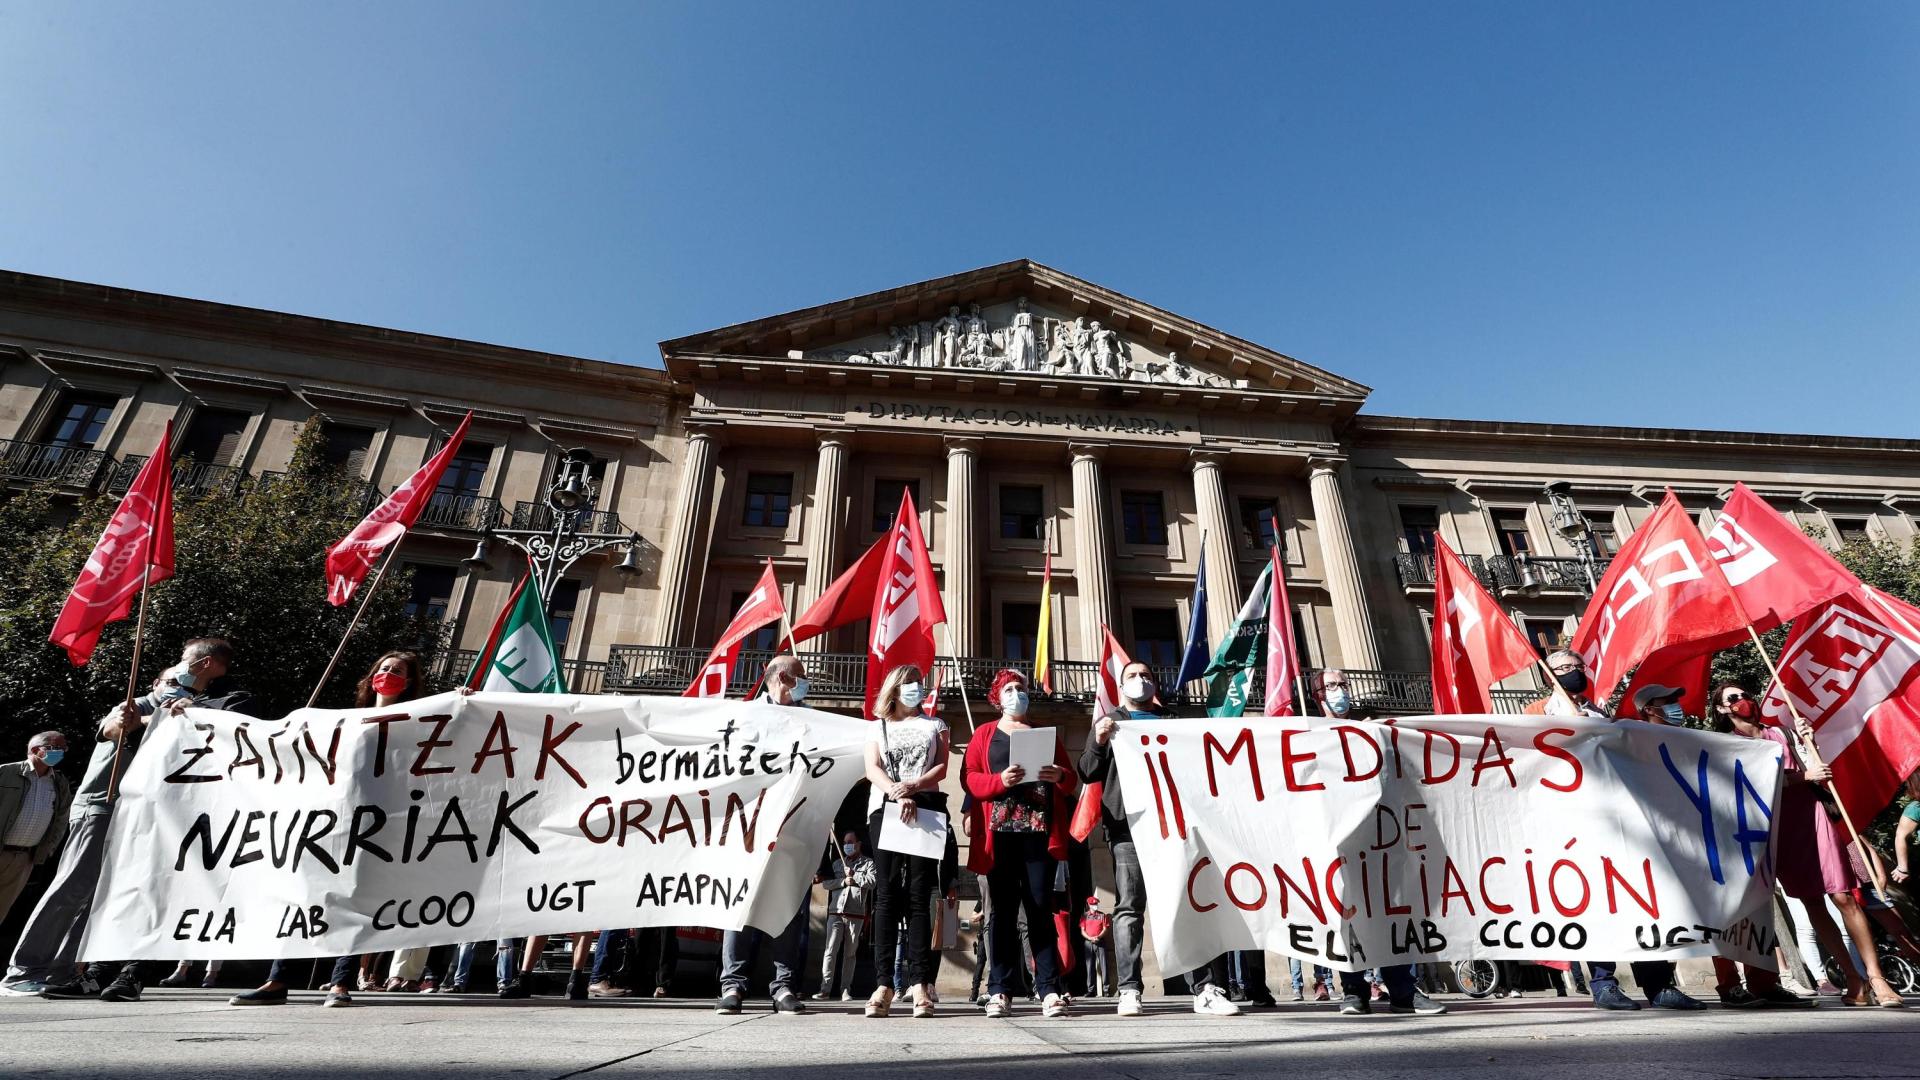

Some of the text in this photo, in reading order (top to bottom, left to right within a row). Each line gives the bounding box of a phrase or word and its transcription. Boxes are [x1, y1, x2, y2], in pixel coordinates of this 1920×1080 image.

[1065, 413, 1180, 436] NAVARRA
[174, 789, 540, 875] NEURRIAK
[1371, 803, 1427, 851] DE
[173, 872, 749, 944] ELA LAB CCOO UGT AFAPNA
[1187, 836, 1660, 925] CONCILIACIÓN
[1288, 922, 1367, 963] ELA
[1391, 918, 1447, 955] LAB
[1479, 919, 1588, 951] CCOO
[1635, 923, 1721, 952] UGT
